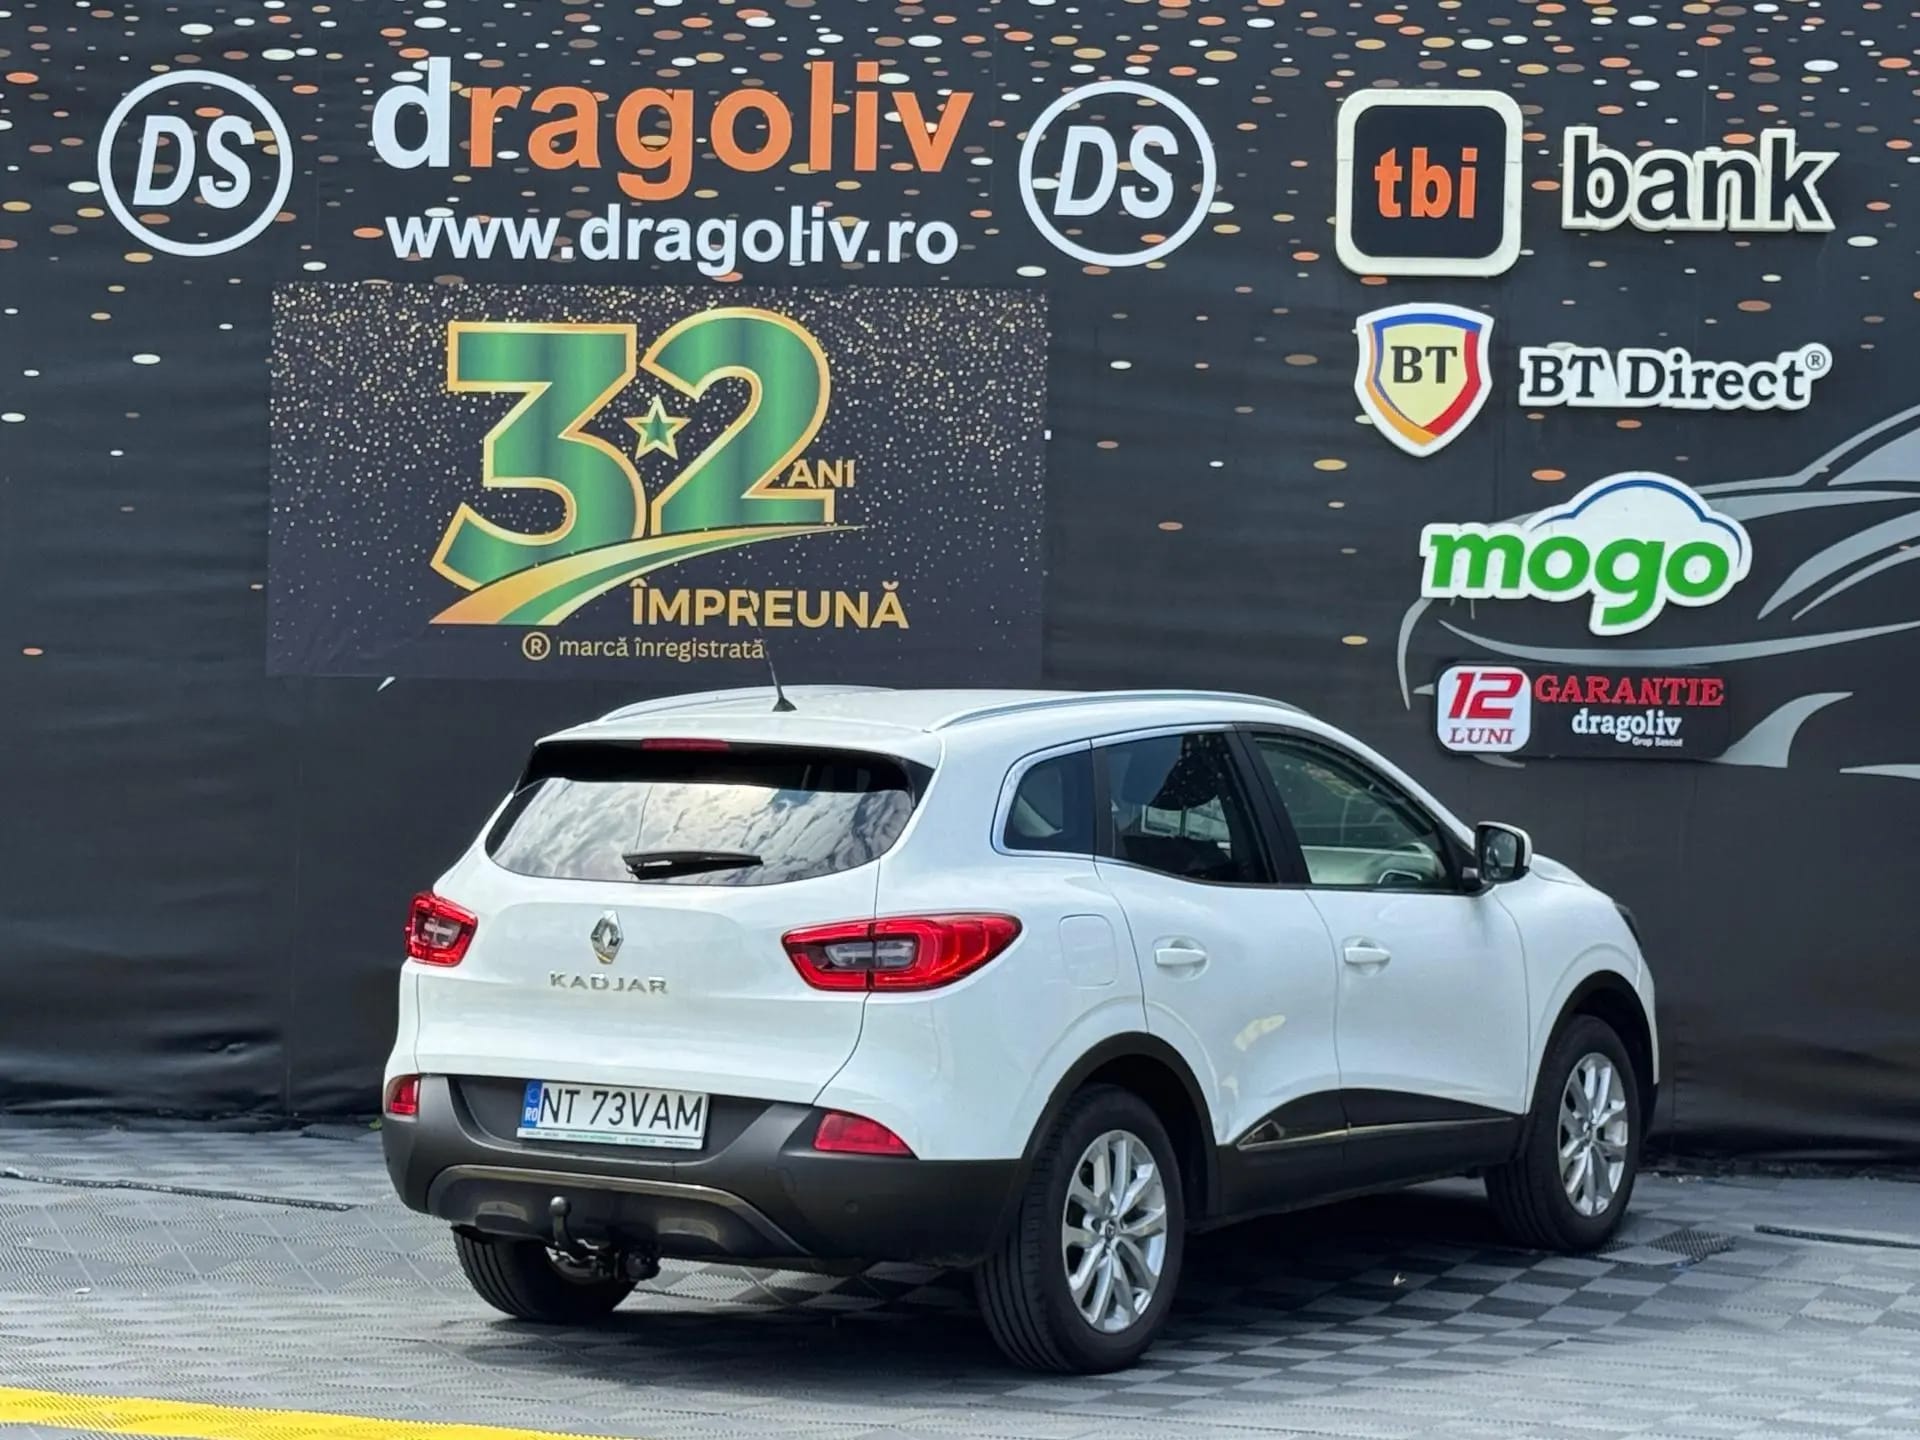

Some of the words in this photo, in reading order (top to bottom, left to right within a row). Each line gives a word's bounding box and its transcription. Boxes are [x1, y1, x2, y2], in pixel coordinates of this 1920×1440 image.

[372, 57, 974, 201] dragoliv
[133, 115, 255, 209] DS
[1053, 125, 1178, 219] DS
[1374, 147, 1479, 219] tbi
[1562, 127, 1839, 230] bank
[385, 203, 959, 277] www.dragoliv.ro
[1390, 345, 1457, 384] BT
[1526, 355, 1606, 398] BT
[430, 307, 831, 591] 32
[788, 459, 855, 488] ANI
[1429, 533, 1730, 627] mogo
[628, 578, 910, 630] ÎMPREUNĂ
[559, 637, 629, 658] marcă
[634, 636, 765, 663] înregistrată
[1448, 672, 1524, 719] 12
[1534, 673, 1724, 706] GARANTIE
[1448, 727, 1516, 745] LUNI
[1571, 707, 1682, 742] dragoliv
[550, 970, 668, 994] KADJAR
[525, 1107, 538, 1121] RO
[540, 1087, 581, 1124] NT
[590, 1090, 703, 1132] 73VAM
